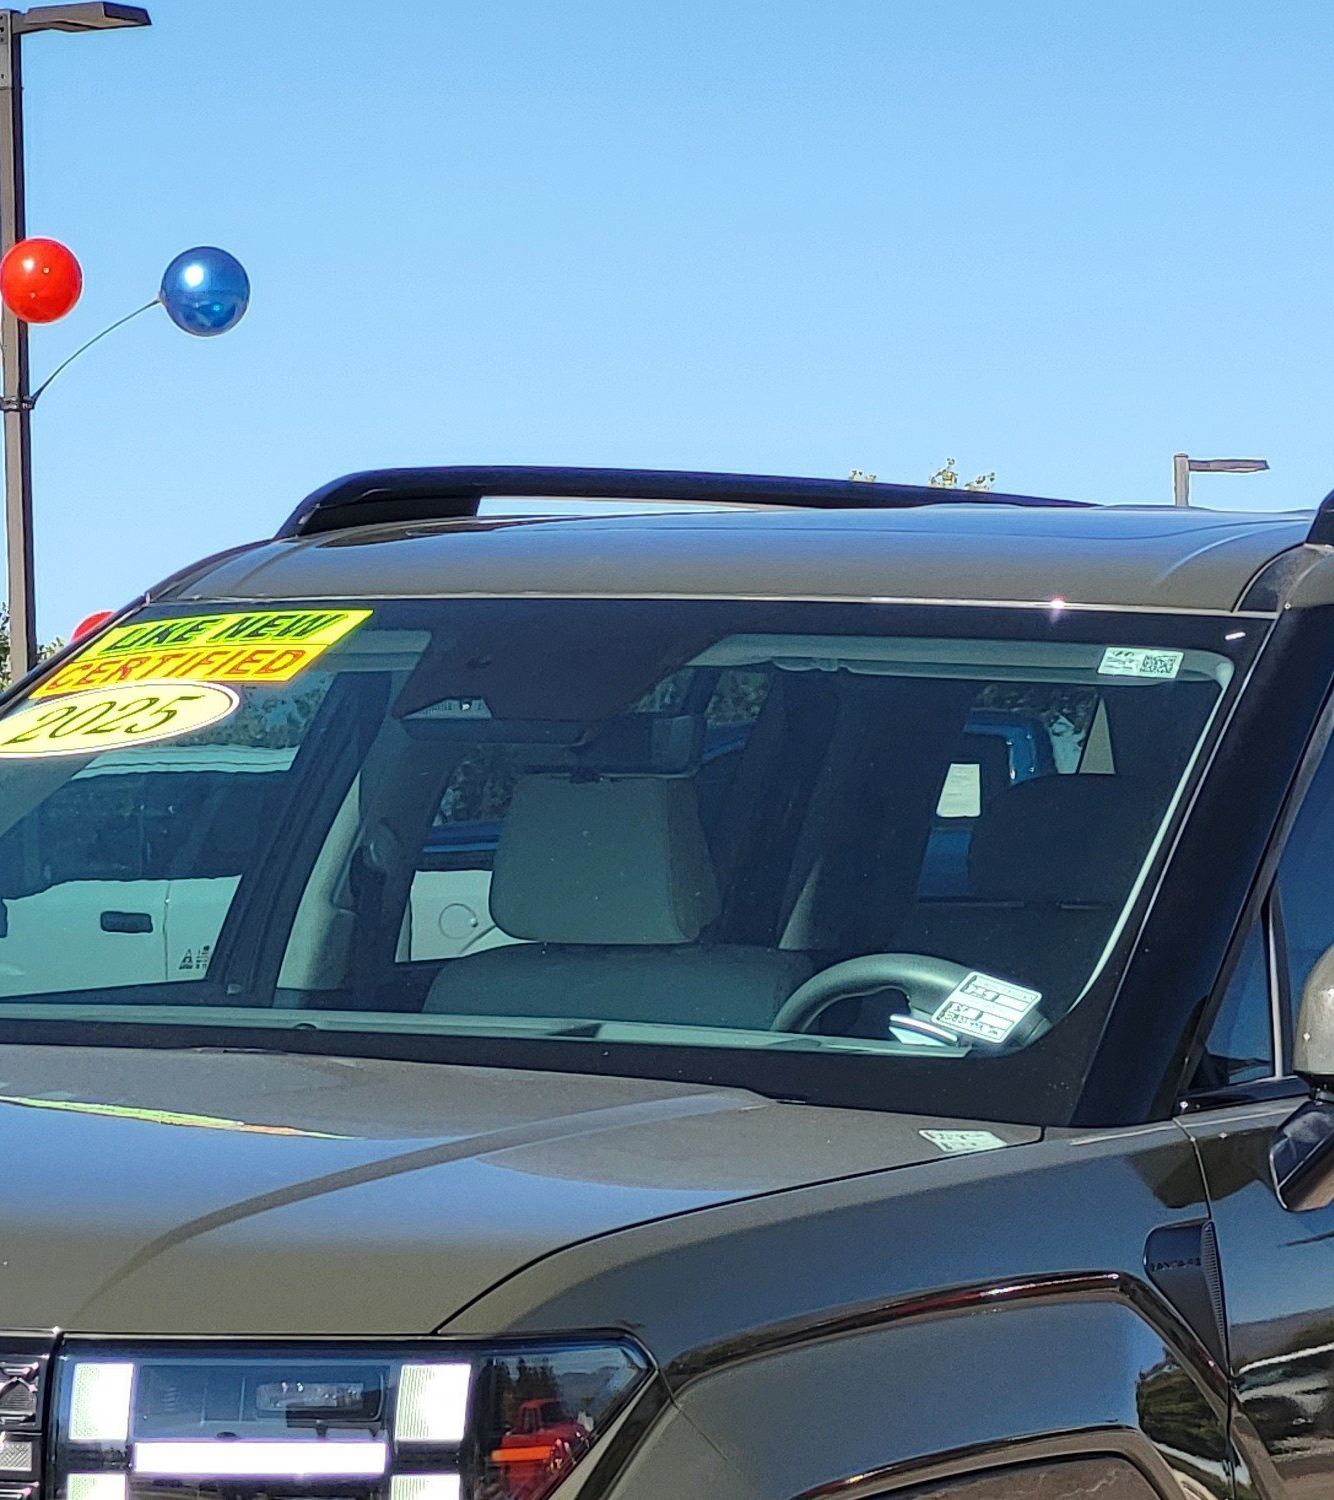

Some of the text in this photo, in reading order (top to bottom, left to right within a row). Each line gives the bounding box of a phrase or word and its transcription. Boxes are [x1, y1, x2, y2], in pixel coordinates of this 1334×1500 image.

[101, 612, 349, 654] LIKE NEW
[46, 649, 306, 691] CERTIFIED
[1, 695, 205, 746] 2025
